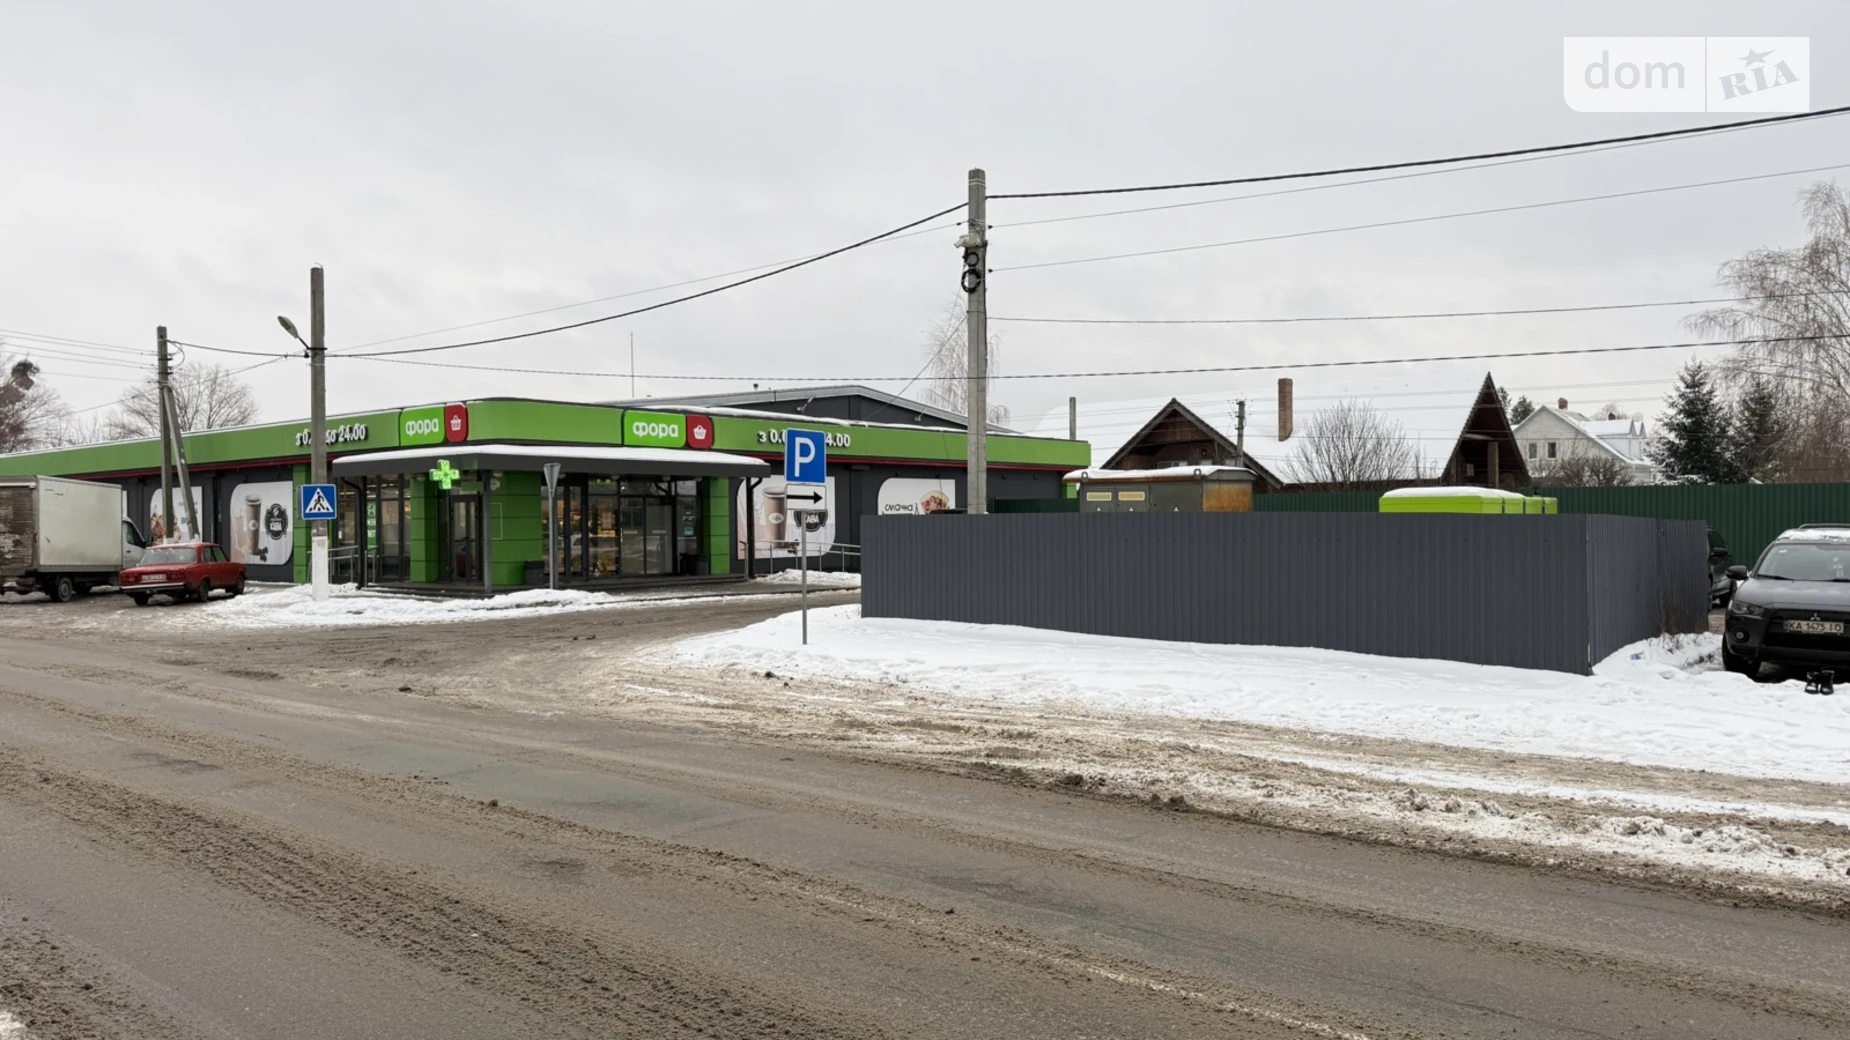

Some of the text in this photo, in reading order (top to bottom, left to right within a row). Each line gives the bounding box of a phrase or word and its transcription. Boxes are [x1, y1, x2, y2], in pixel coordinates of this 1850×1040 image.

[338, 423, 367, 443] 24.00
[405, 418, 439, 437] фора
[632, 421, 679, 439] фора
[758, 431, 767, 443] з
[825, 431, 851, 447] 4.00
[794, 436, 816, 478] P
